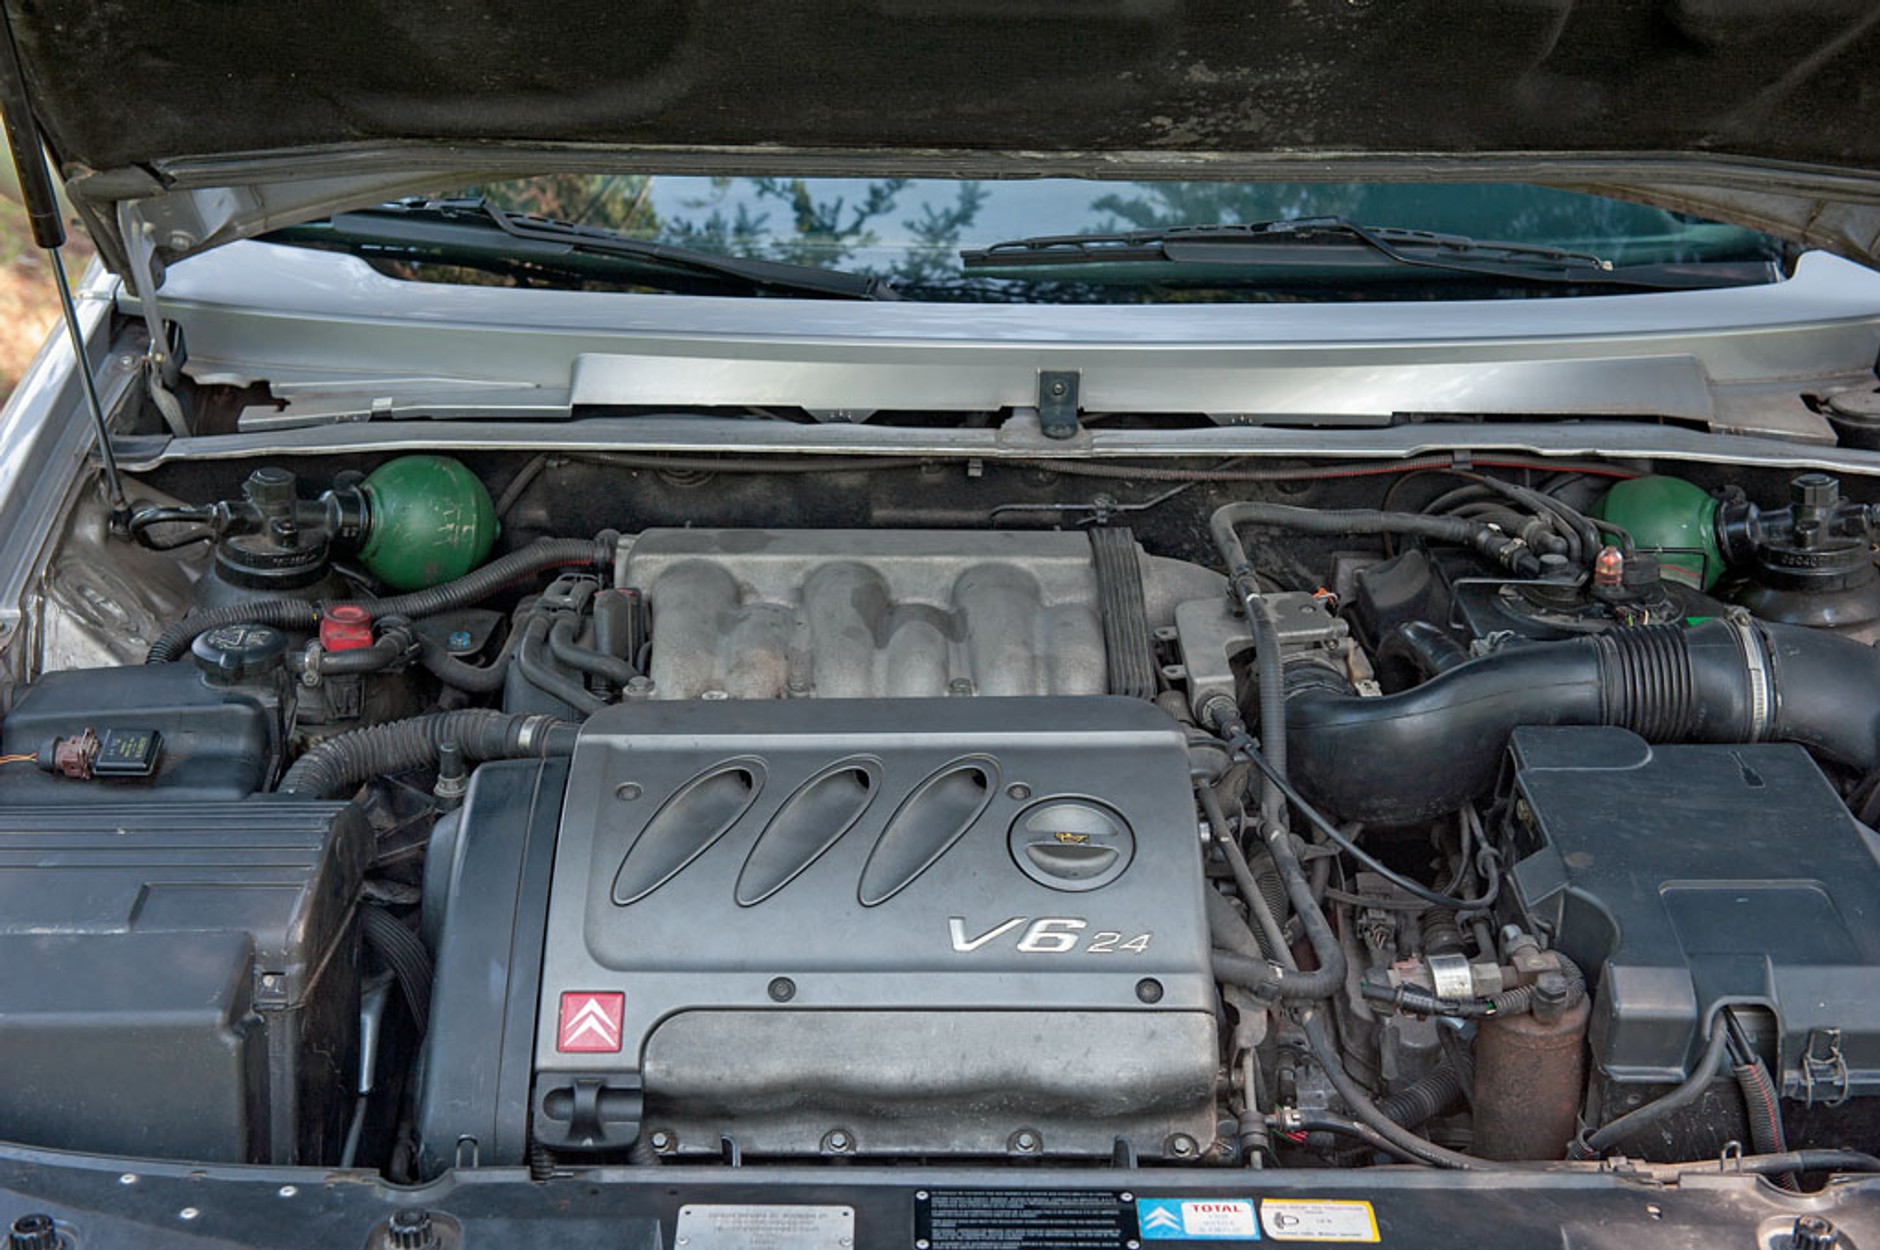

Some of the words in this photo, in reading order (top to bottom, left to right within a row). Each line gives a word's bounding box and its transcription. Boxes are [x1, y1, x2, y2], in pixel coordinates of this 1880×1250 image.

[949, 917, 1087, 952] V6
[1087, 931, 1152, 953] 24
[1191, 1204, 1243, 1213] TOTAL
